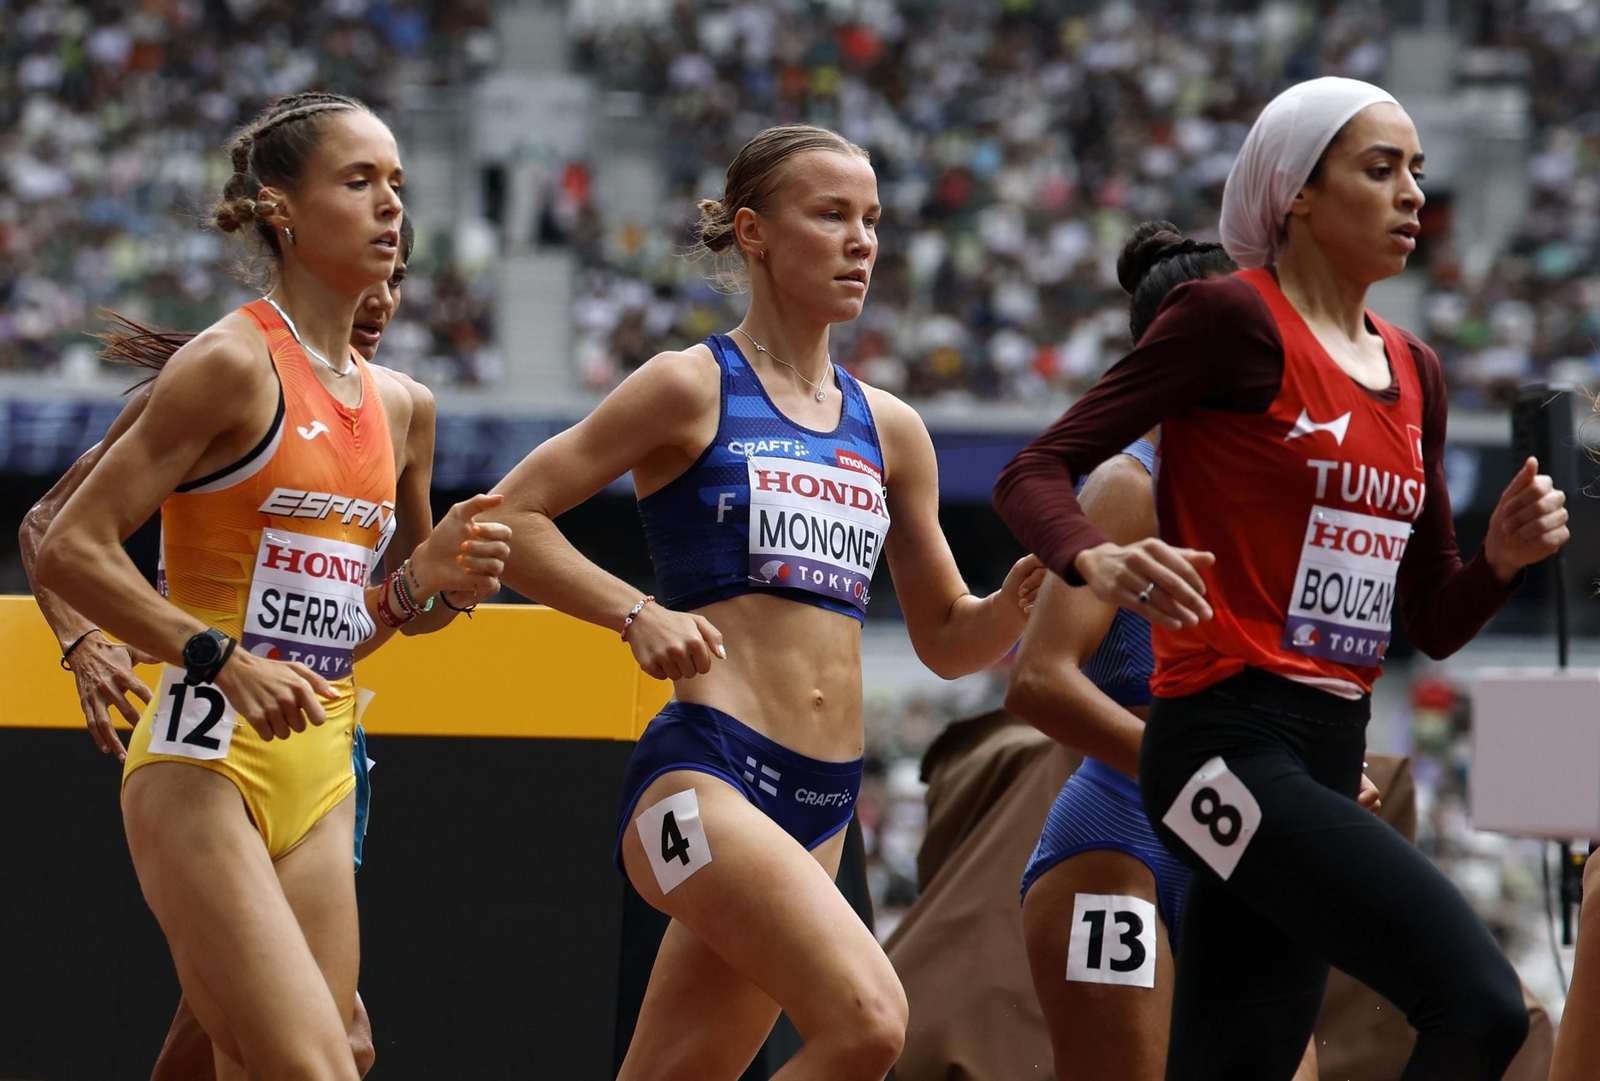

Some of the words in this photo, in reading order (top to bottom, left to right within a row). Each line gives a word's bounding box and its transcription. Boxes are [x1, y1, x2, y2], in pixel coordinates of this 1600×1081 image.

[728, 440, 793, 456] CRAFT
[754, 469, 889, 520] HONDA
[166, 683, 226, 751] 12
[794, 788, 841, 807] CRAFT
[1191, 787, 1243, 847] 8
[661, 810, 690, 867] 4
[1082, 910, 1146, 972] 13
